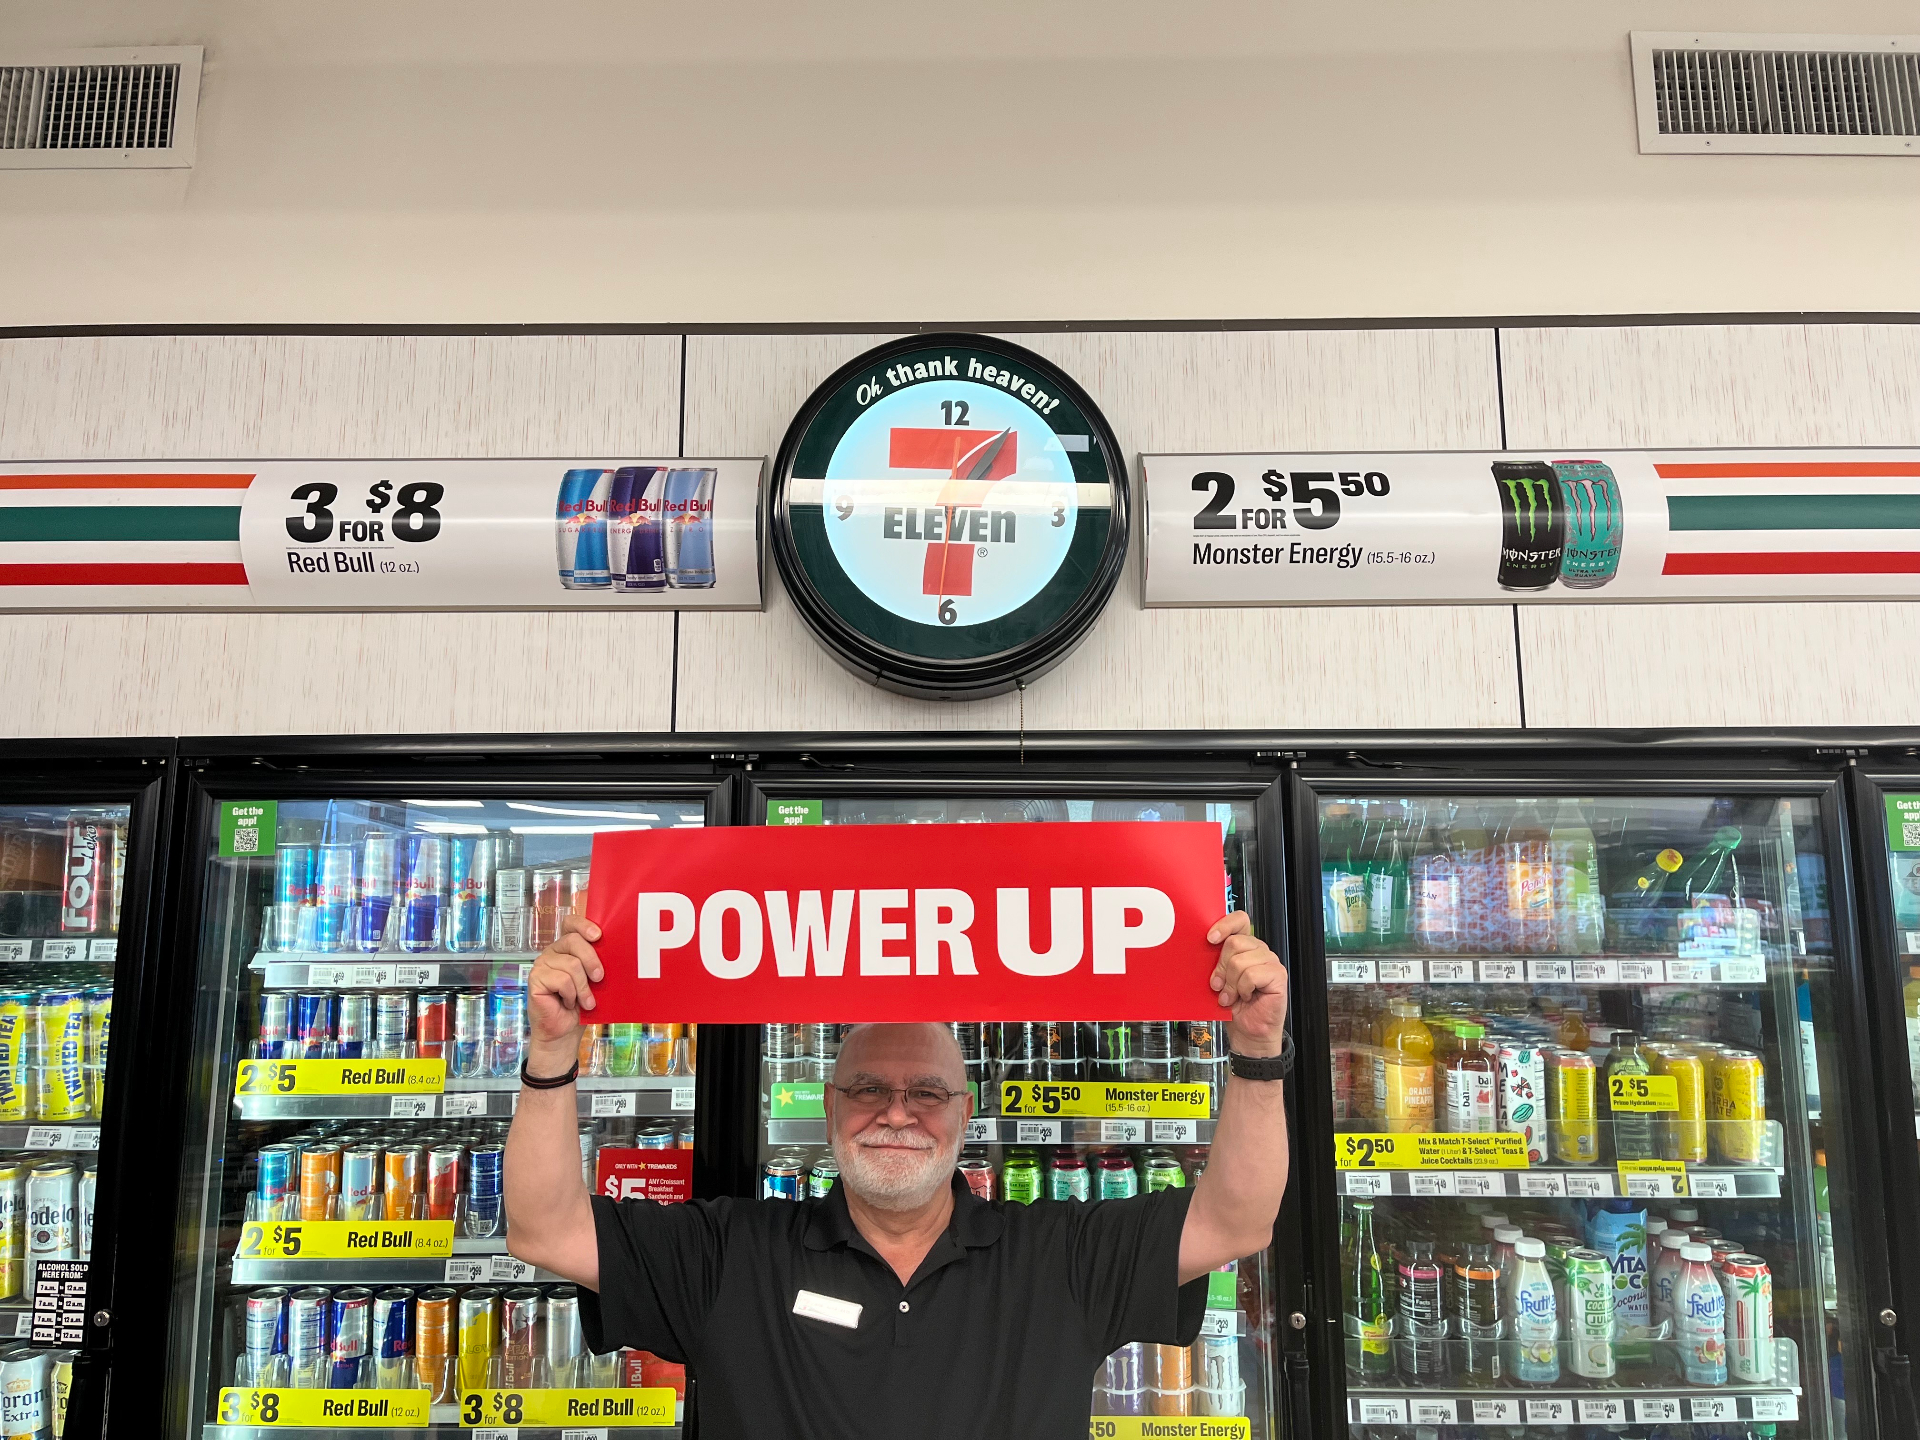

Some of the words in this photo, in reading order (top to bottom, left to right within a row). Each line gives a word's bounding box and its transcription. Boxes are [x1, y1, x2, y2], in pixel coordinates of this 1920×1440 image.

[856, 376, 883, 406] Oh
[886, 356, 958, 387] thank
[968, 358, 1060, 415] heaven!
[941, 400, 970, 426] 12
[559, 499, 582, 512] Red
[610, 499, 635, 512] Red
[638, 499, 662, 512] Bull
[664, 499, 687, 512] Red
[690, 500, 712, 512] Bull
[835, 494, 855, 521] 9
[1191, 471, 1237, 530] 2
[1241, 508, 1286, 530] FOR
[285, 482, 338, 543] 3
[339, 520, 384, 542] FOR
[365, 479, 445, 543] $8
[1051, 502, 1066, 528] 3
[287, 551, 330, 574] Red
[334, 551, 375, 574] Bull
[380, 561, 397, 575] (12
[399, 561, 420, 575] oz.)
[1193, 542, 1287, 566] Monster
[1290, 542, 1364, 570] Energy
[1366, 552, 1412, 566] (15.5-16
[1414, 551, 1436, 565] oz.)
[938, 598, 957, 626] 6
[233, 807, 247, 817] Get
[249, 806, 264, 816] the
[779, 806, 793, 814] Get
[794, 806, 809, 814] the
[1897, 801, 1910, 810] Get
[237, 816, 257, 826] app!
[784, 815, 803, 825] app!
[81, 825, 98, 860] Loko
[637, 889, 979, 980] POWER
[996, 886, 1176, 977] UP
[63, 1013, 83, 1038] TEA
[62, 1041, 84, 1102] TWISTED
[240, 1065, 259, 1092] 2
[268, 1063, 297, 1092] $5
[341, 1068, 372, 1085] Red
[375, 1068, 405, 1085] Bull
[408, 1075, 424, 1085] (8.4
[426, 1075, 441, 1085] oz.)
[1613, 1079, 1624, 1097] 2
[1629, 1078, 1649, 1097] $5
[1005, 1085, 1023, 1114] 2
[1025, 1104, 1037, 1114] for
[1105, 1088, 1160, 1102] Monster
[1162, 1088, 1205, 1105] Energy
[1137, 1103, 1151, 1113] oz.)
[1340, 1158, 1353, 1167] for
[1421, 1157, 1439, 1165] Juice
[1440, 1157, 1473, 1165] Cocktails
[245, 1227, 264, 1256] 2
[273, 1225, 302, 1256] $5
[347, 1231, 380, 1249] Red
[382, 1231, 413, 1249] Bull
[415, 1238, 431, 1249] (8.4
[433, 1238, 449, 1249] oz.)
[70, 1264, 89, 1272] SOLD
[1610, 1254, 1647, 1274] VITA
[42, 1271, 60, 1279] HERE
[337, 1340, 358, 1351] Bull
[632, 1360, 642, 1380] Bull
[3, 1409, 40, 1423] Extra
[222, 1393, 240, 1423] 3
[251, 1391, 280, 1423] $8
[323, 1400, 355, 1417] Red
[358, 1400, 389, 1417] Bull
[392, 1407, 404, 1417] (12
[405, 1407, 420, 1417] oz.)
[464, 1395, 483, 1425] 3
[493, 1393, 523, 1425] $8
[568, 1399, 599, 1417] Red
[603, 1399, 634, 1417] Bull
[637, 1407, 650, 1417] (12
[651, 1407, 666, 1417] oz.)
[1142, 1422, 1198, 1438] Monster
[1200, 1422, 1246, 1440] Energy
